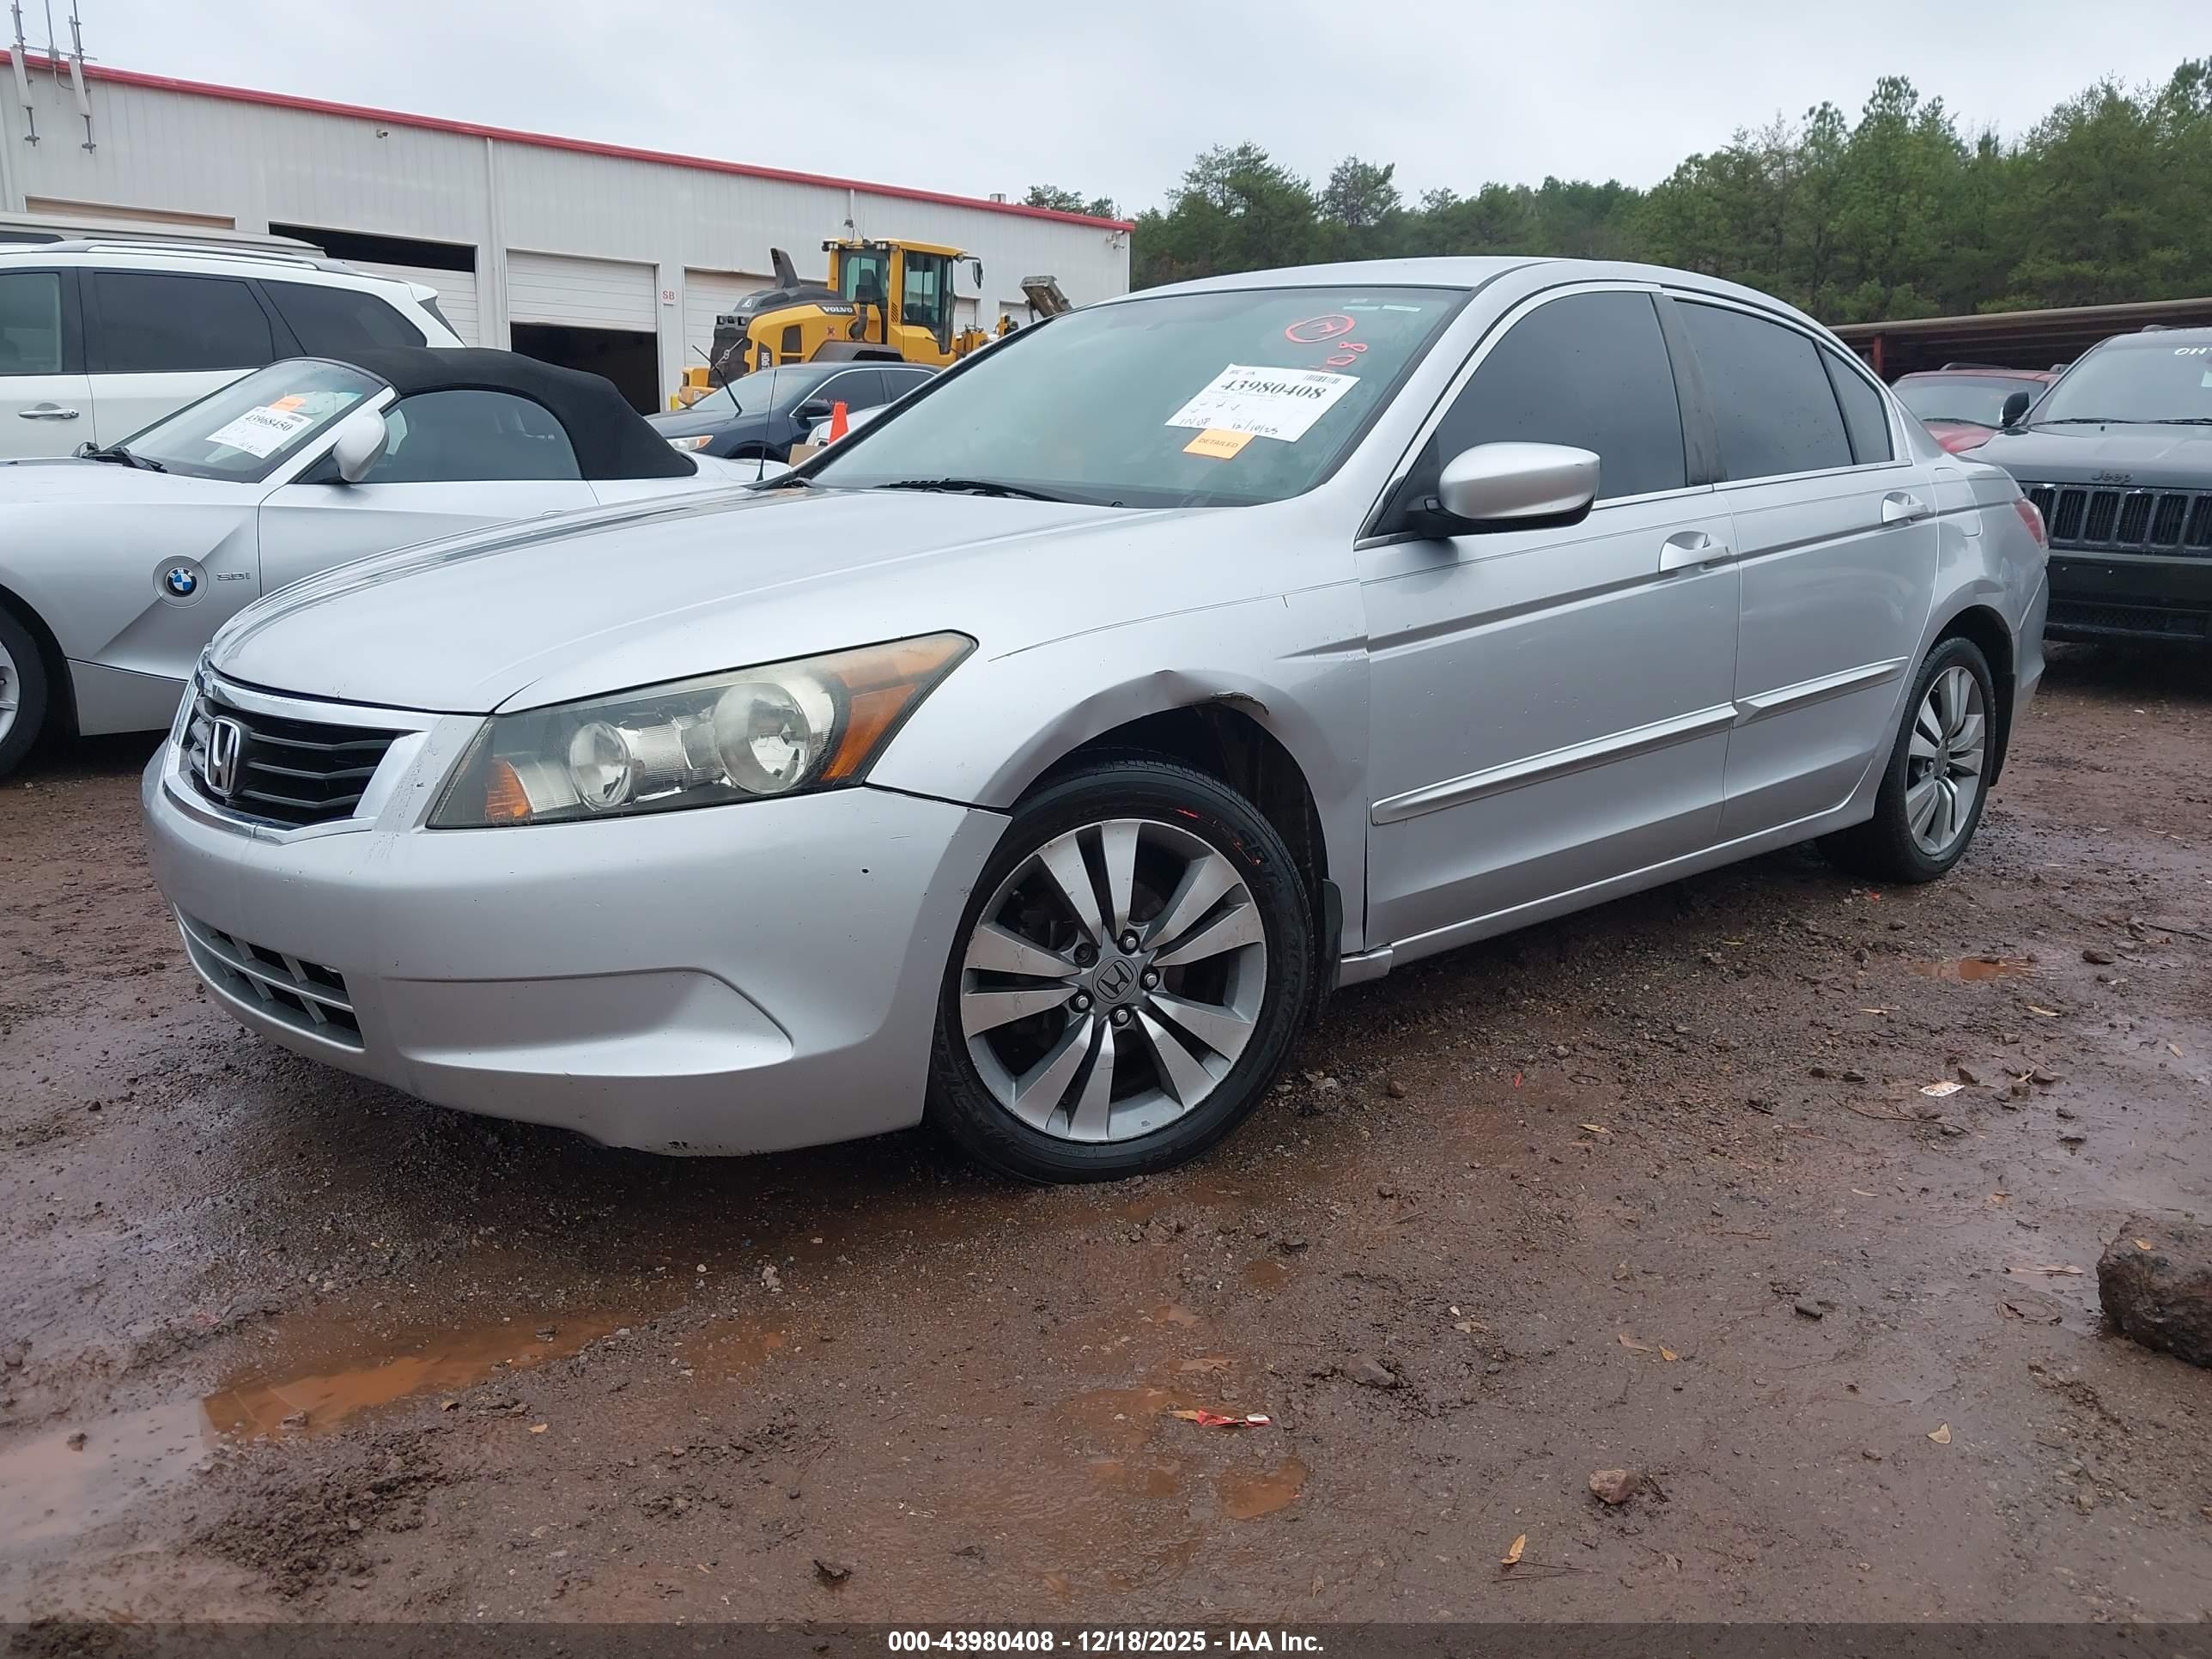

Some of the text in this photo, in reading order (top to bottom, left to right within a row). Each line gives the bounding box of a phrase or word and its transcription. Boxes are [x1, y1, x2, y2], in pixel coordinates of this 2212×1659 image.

[662, 290, 675, 301] SB
[1221, 379, 1327, 399] 43980408
[246, 414, 294, 432] 43968450
[1197, 438, 1239, 449] DETAILED
[2091, 470, 2133, 484] Jeep
